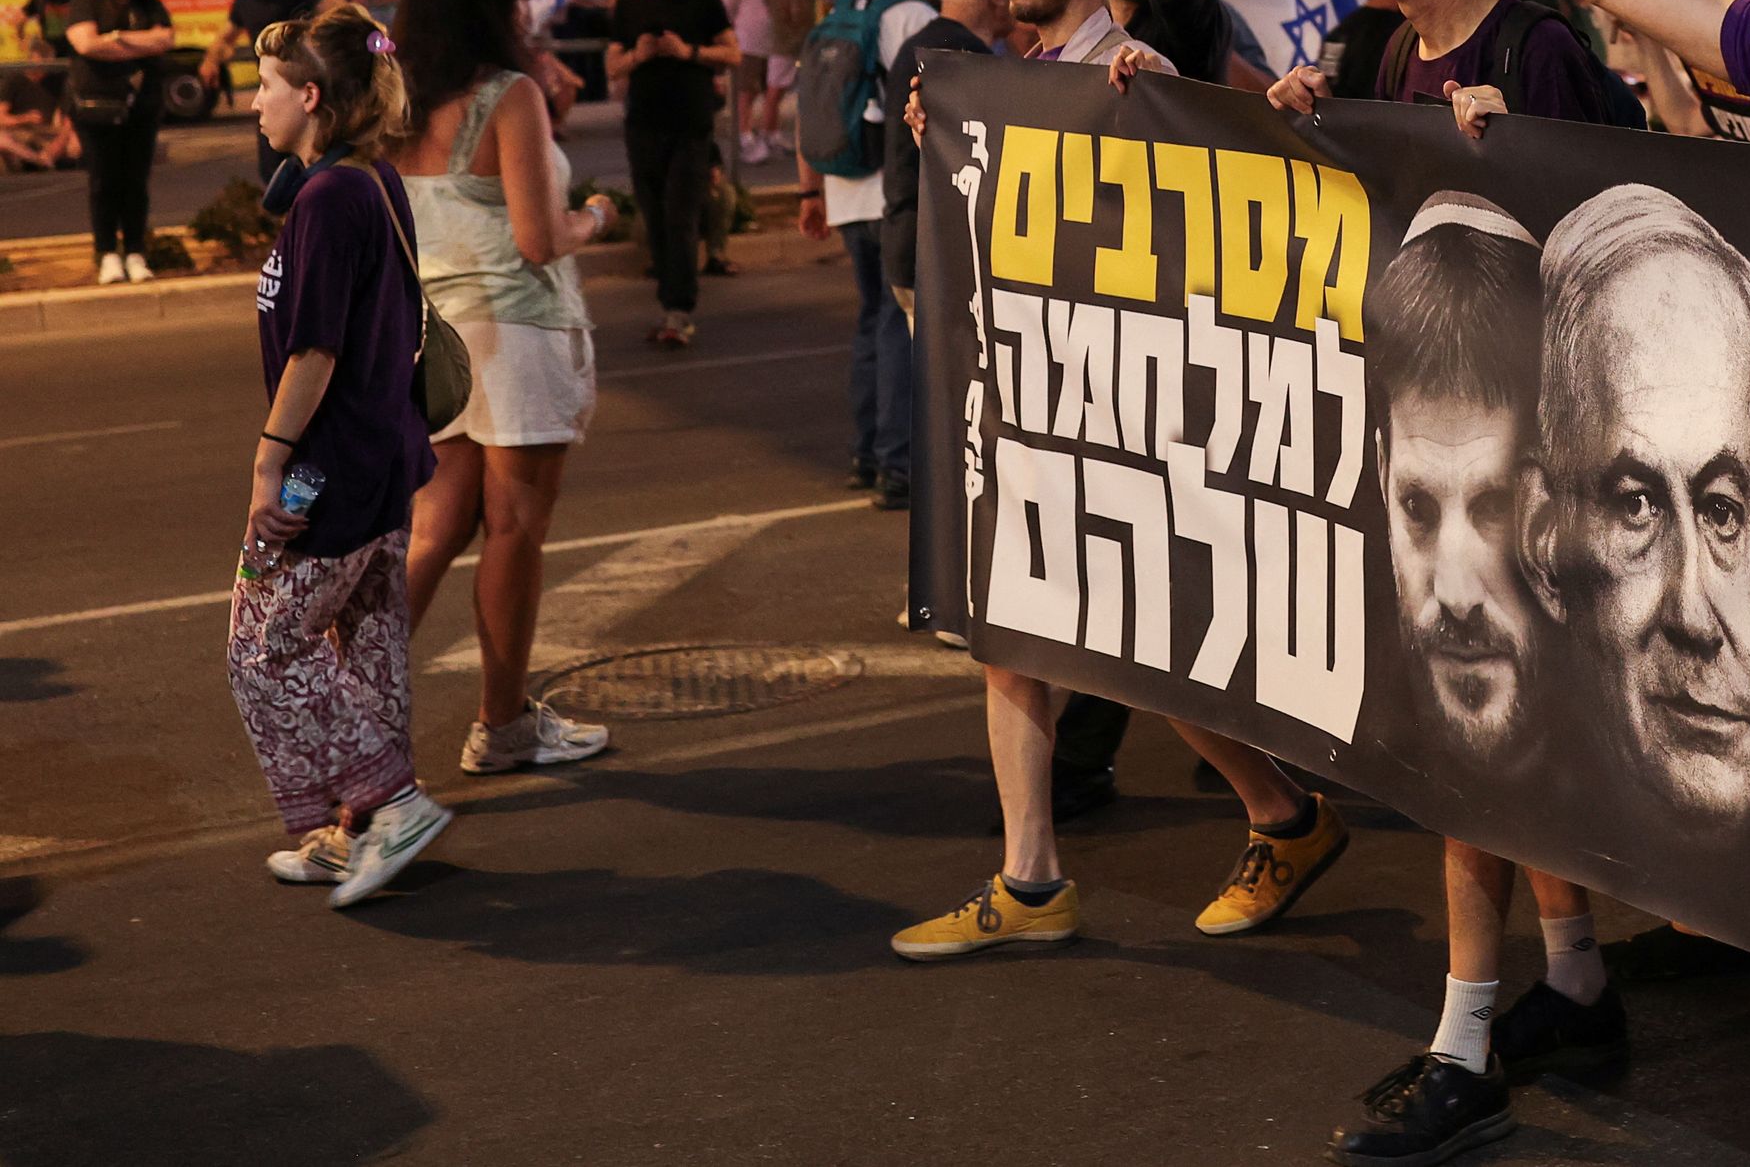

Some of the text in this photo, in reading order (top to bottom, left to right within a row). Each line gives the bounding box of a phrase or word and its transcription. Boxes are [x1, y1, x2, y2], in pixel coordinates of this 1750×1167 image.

[990, 124, 1372, 342] מסרבים
[991, 286, 1365, 510] למלחמה
[985, 436, 1365, 745] שלהם
